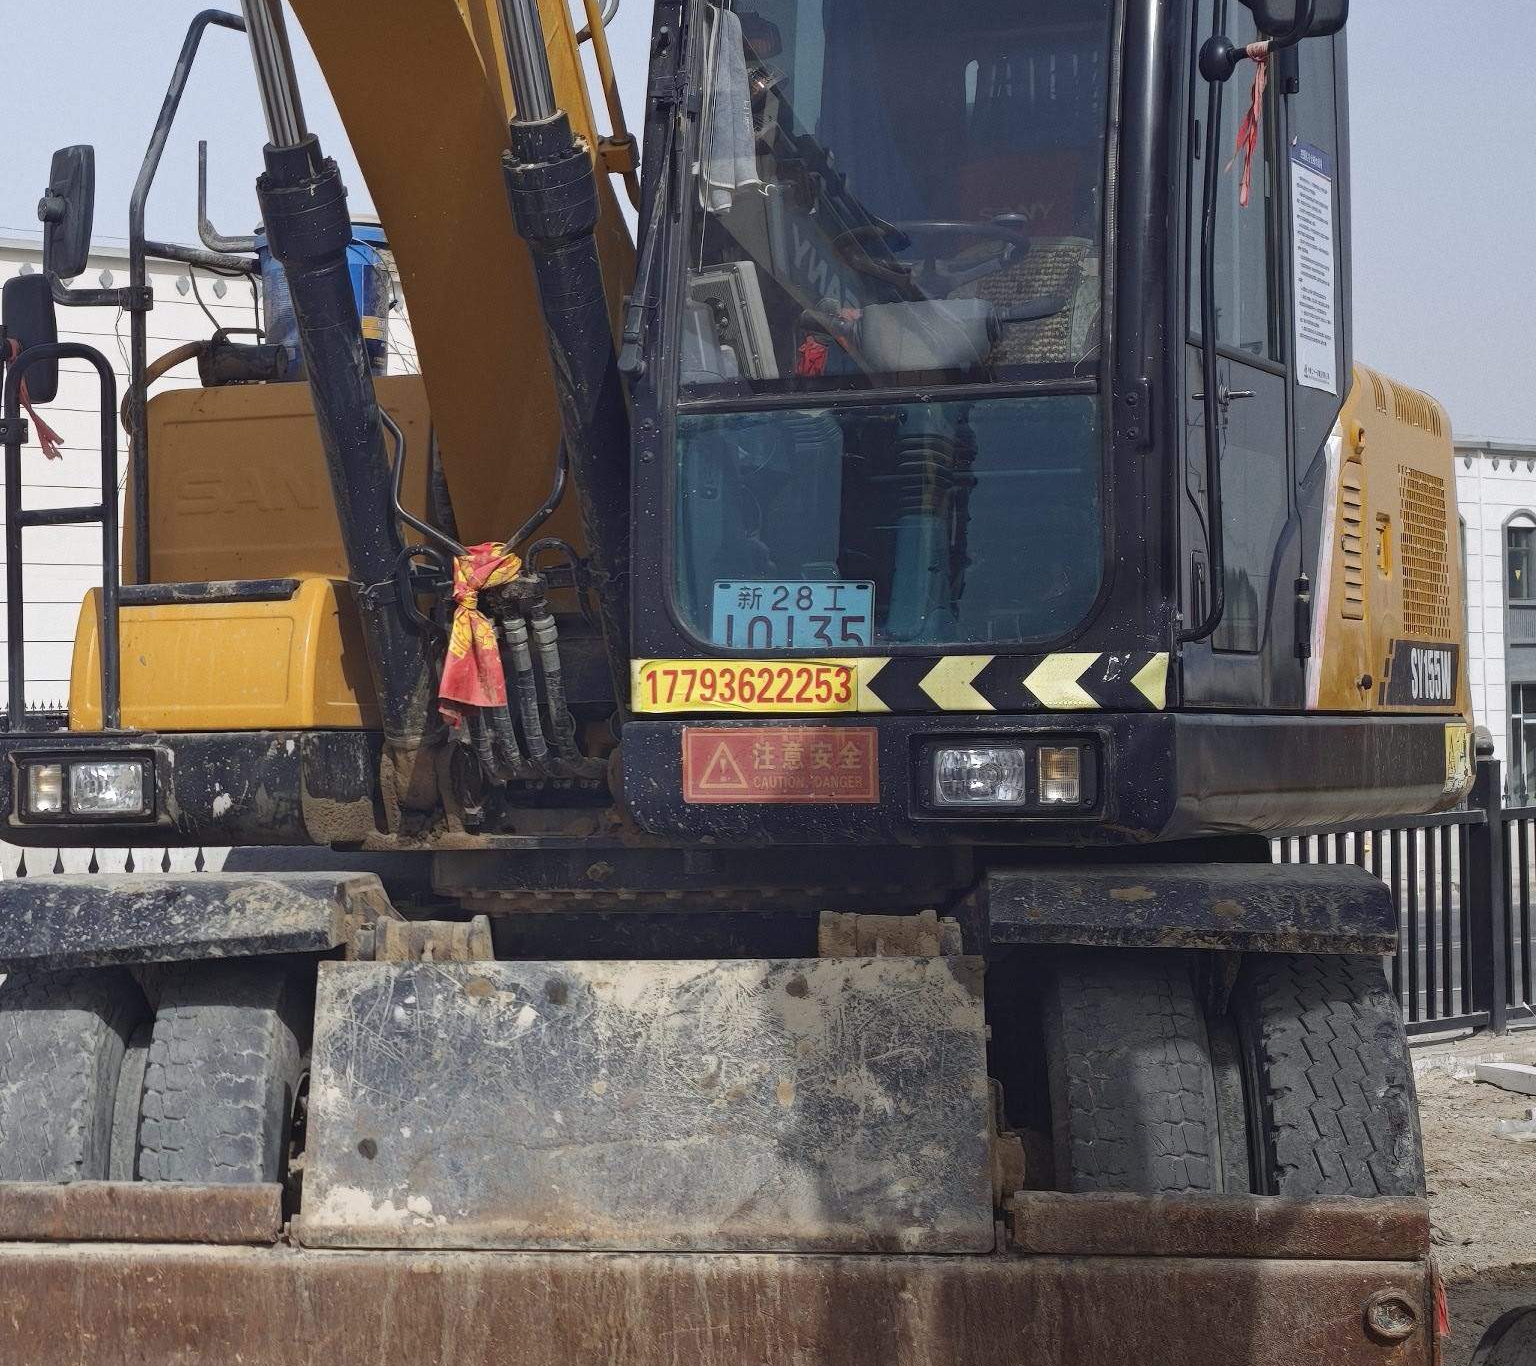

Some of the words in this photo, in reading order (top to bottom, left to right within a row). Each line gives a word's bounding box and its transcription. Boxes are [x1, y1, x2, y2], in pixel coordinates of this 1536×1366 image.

[175, 467, 322, 516] SAN
[646, 667, 852, 704] 17793622253
[1410, 647, 1451, 700] SY155W
[752, 741, 863, 770] 注意安全
[815, 775, 864, 788] DANGER
